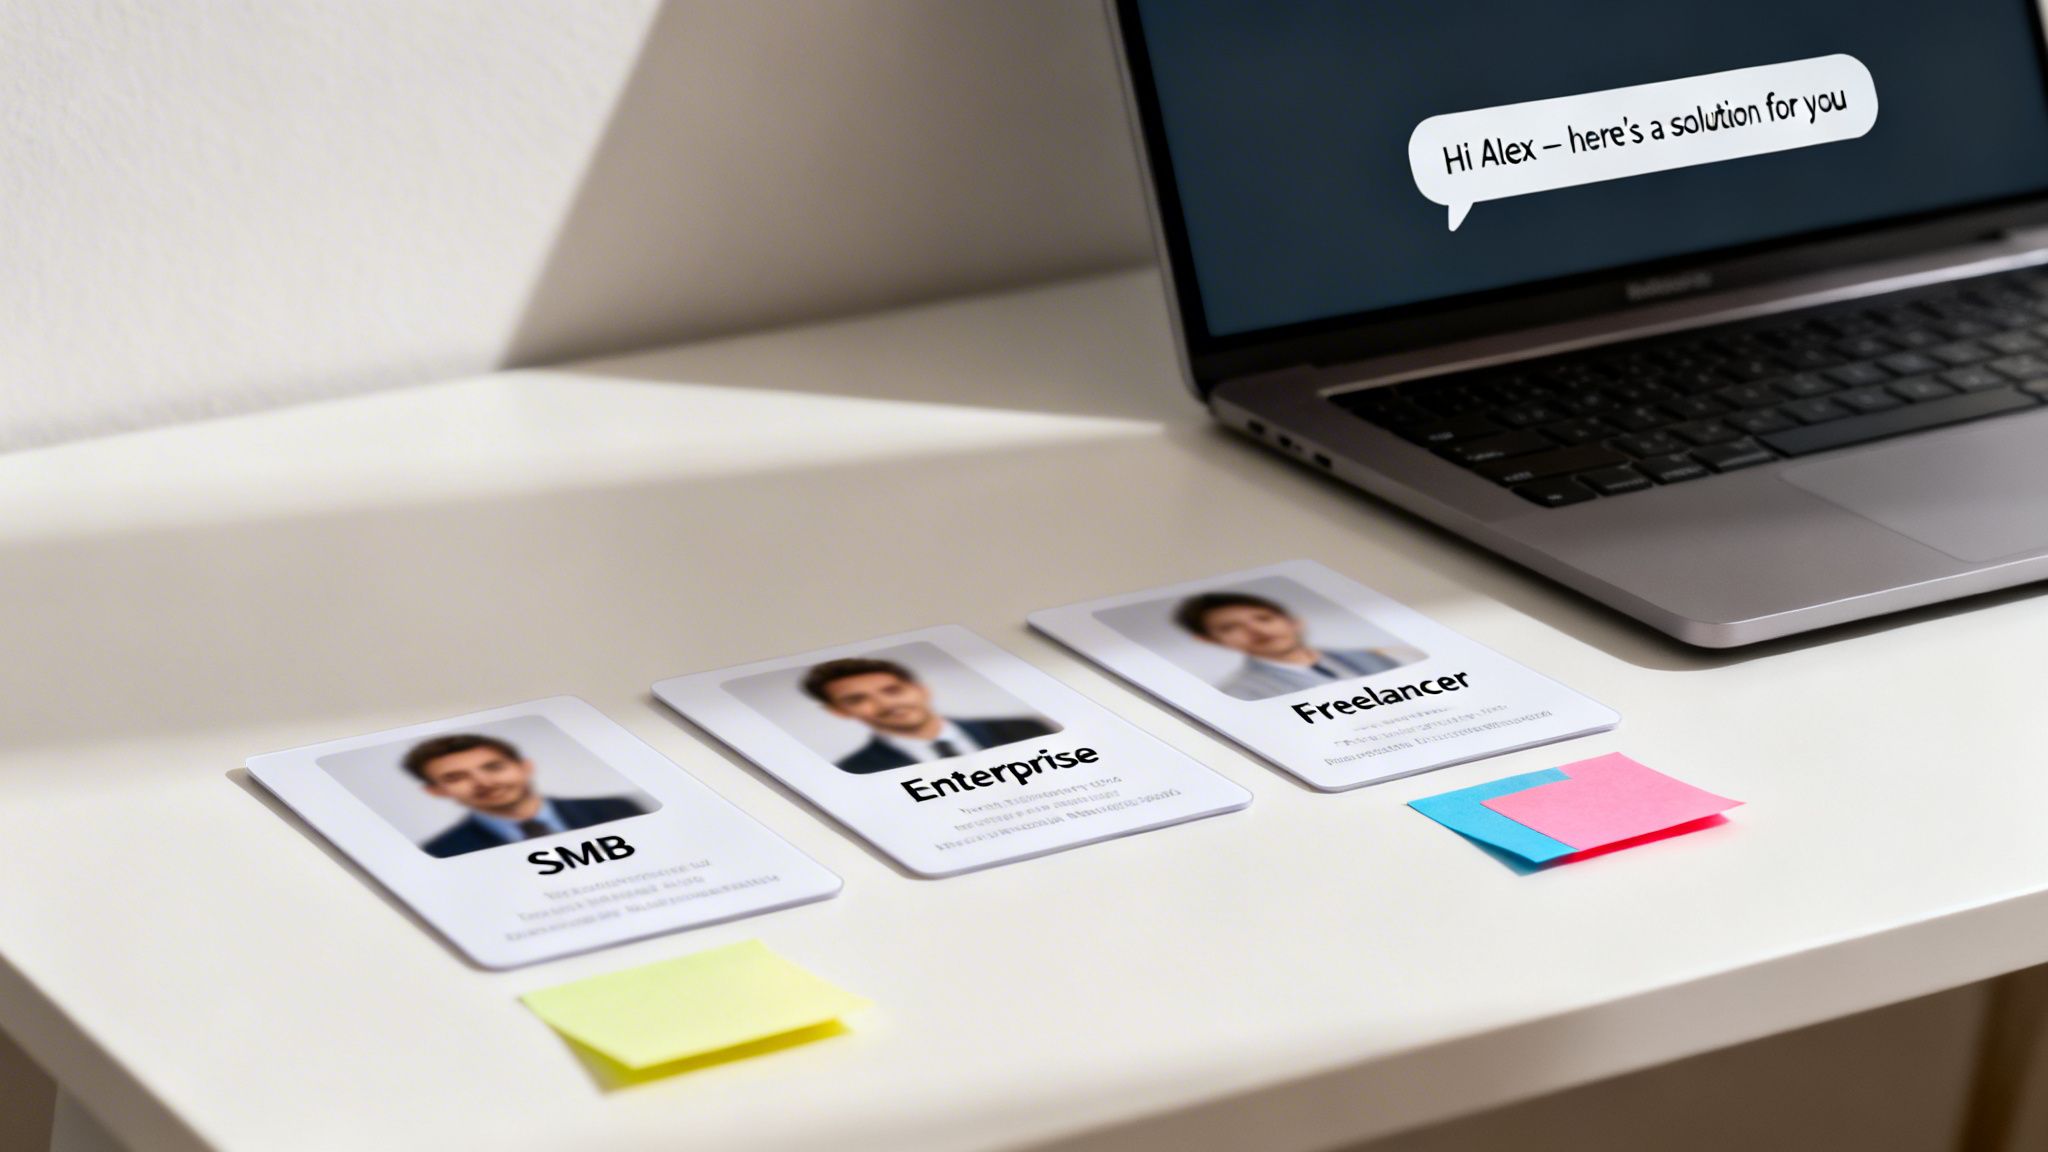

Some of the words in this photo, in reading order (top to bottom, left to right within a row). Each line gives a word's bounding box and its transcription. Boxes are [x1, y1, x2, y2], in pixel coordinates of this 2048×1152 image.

[1442, 142, 1473, 175] Hi
[1481, 137, 1537, 168] Alex
[1567, 116, 1644, 154] here's
[1650, 120, 1665, 141] a
[1670, 100, 1762, 137] solution
[1765, 91, 1799, 122] for
[1802, 89, 1848, 125] you
[1291, 671, 1469, 725] Freelancer
[900, 746, 1099, 803] Enterprise
[527, 835, 636, 876] SMB
